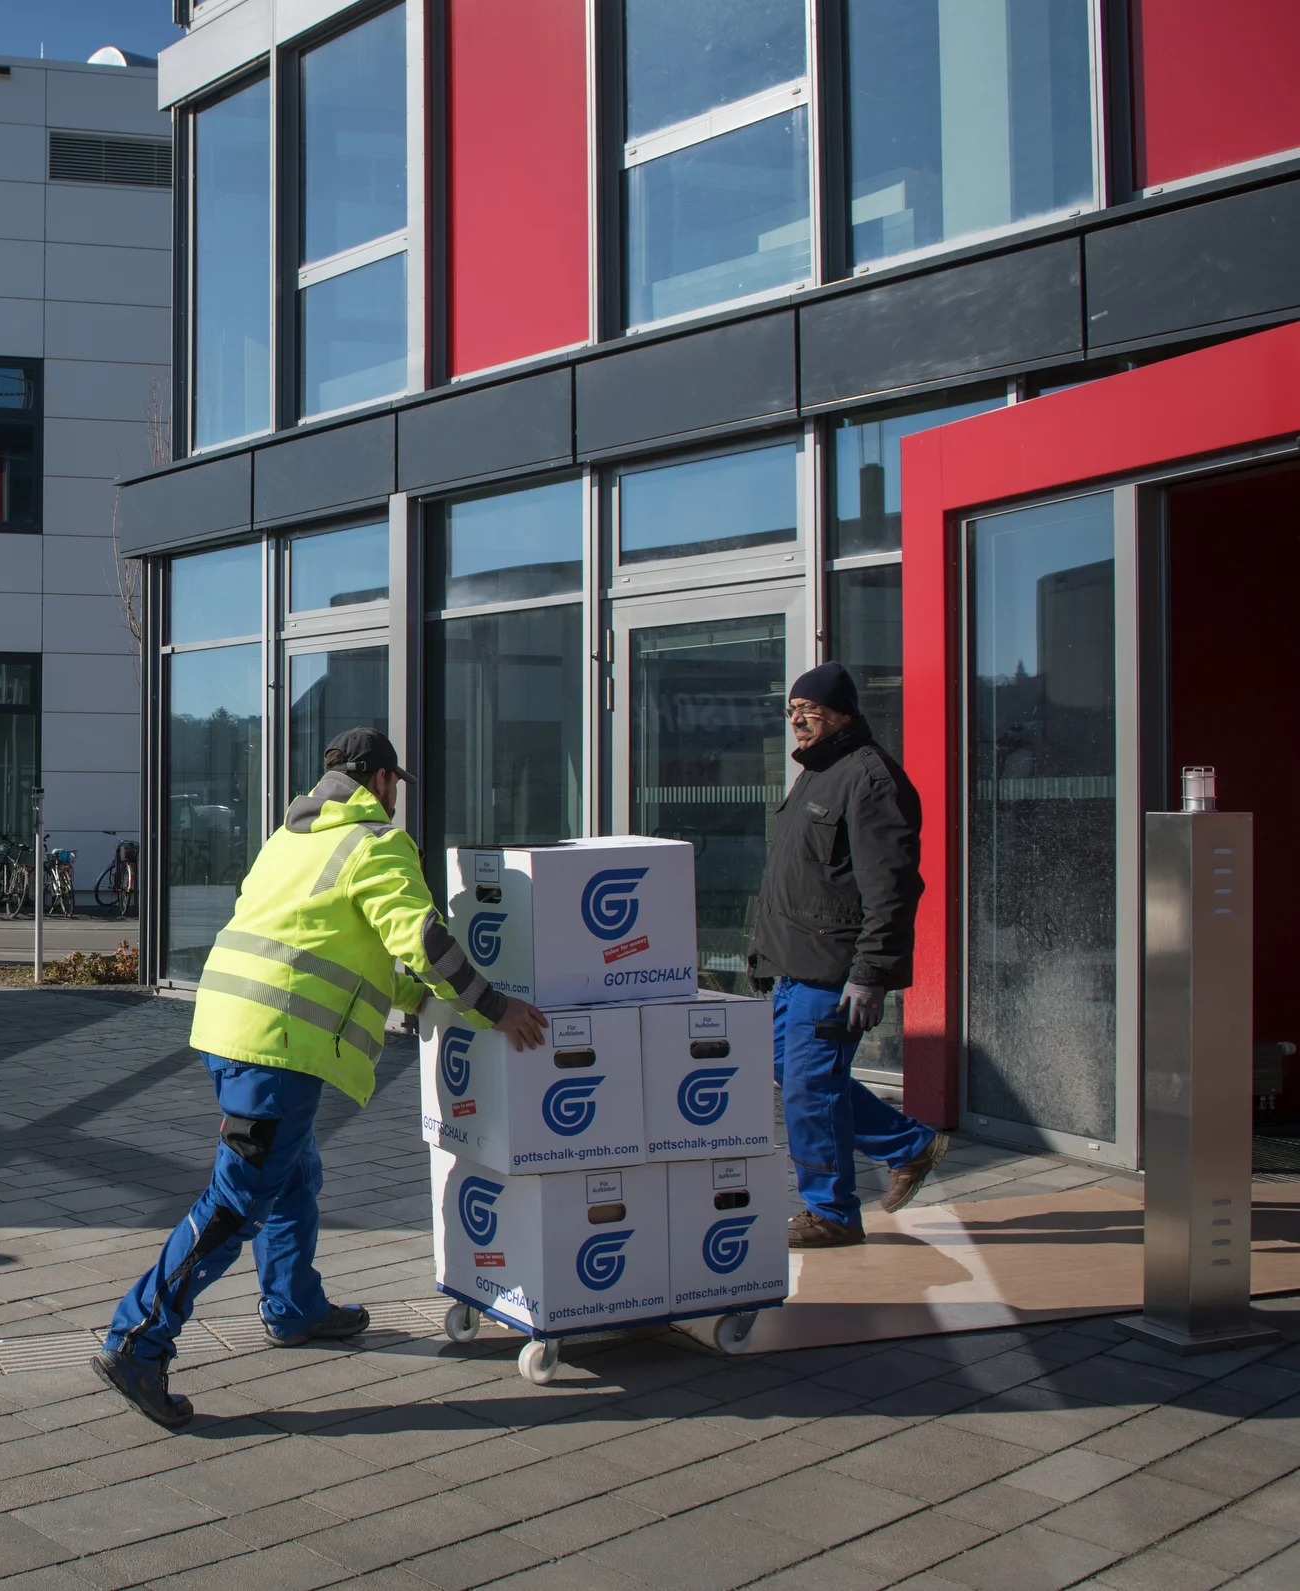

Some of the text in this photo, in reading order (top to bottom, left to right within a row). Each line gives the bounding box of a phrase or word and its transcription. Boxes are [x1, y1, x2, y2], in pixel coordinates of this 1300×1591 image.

[603, 947, 619, 957] Value
[629, 937, 647, 948] money
[604, 966, 692, 986] GOTTSCHALK
[423, 1115, 468, 1144] GOTTSCHALK
[513, 1143, 639, 1166] gottschalk-gmbh.com
[648, 1134, 768, 1153] gottschalk-gmbh.com
[476, 1276, 539, 1315] GOTTSCHALK
[675, 1277, 784, 1304] gottschalk-gmbh.com
[549, 1295, 664, 1321] gottschalk-gmbh.com
